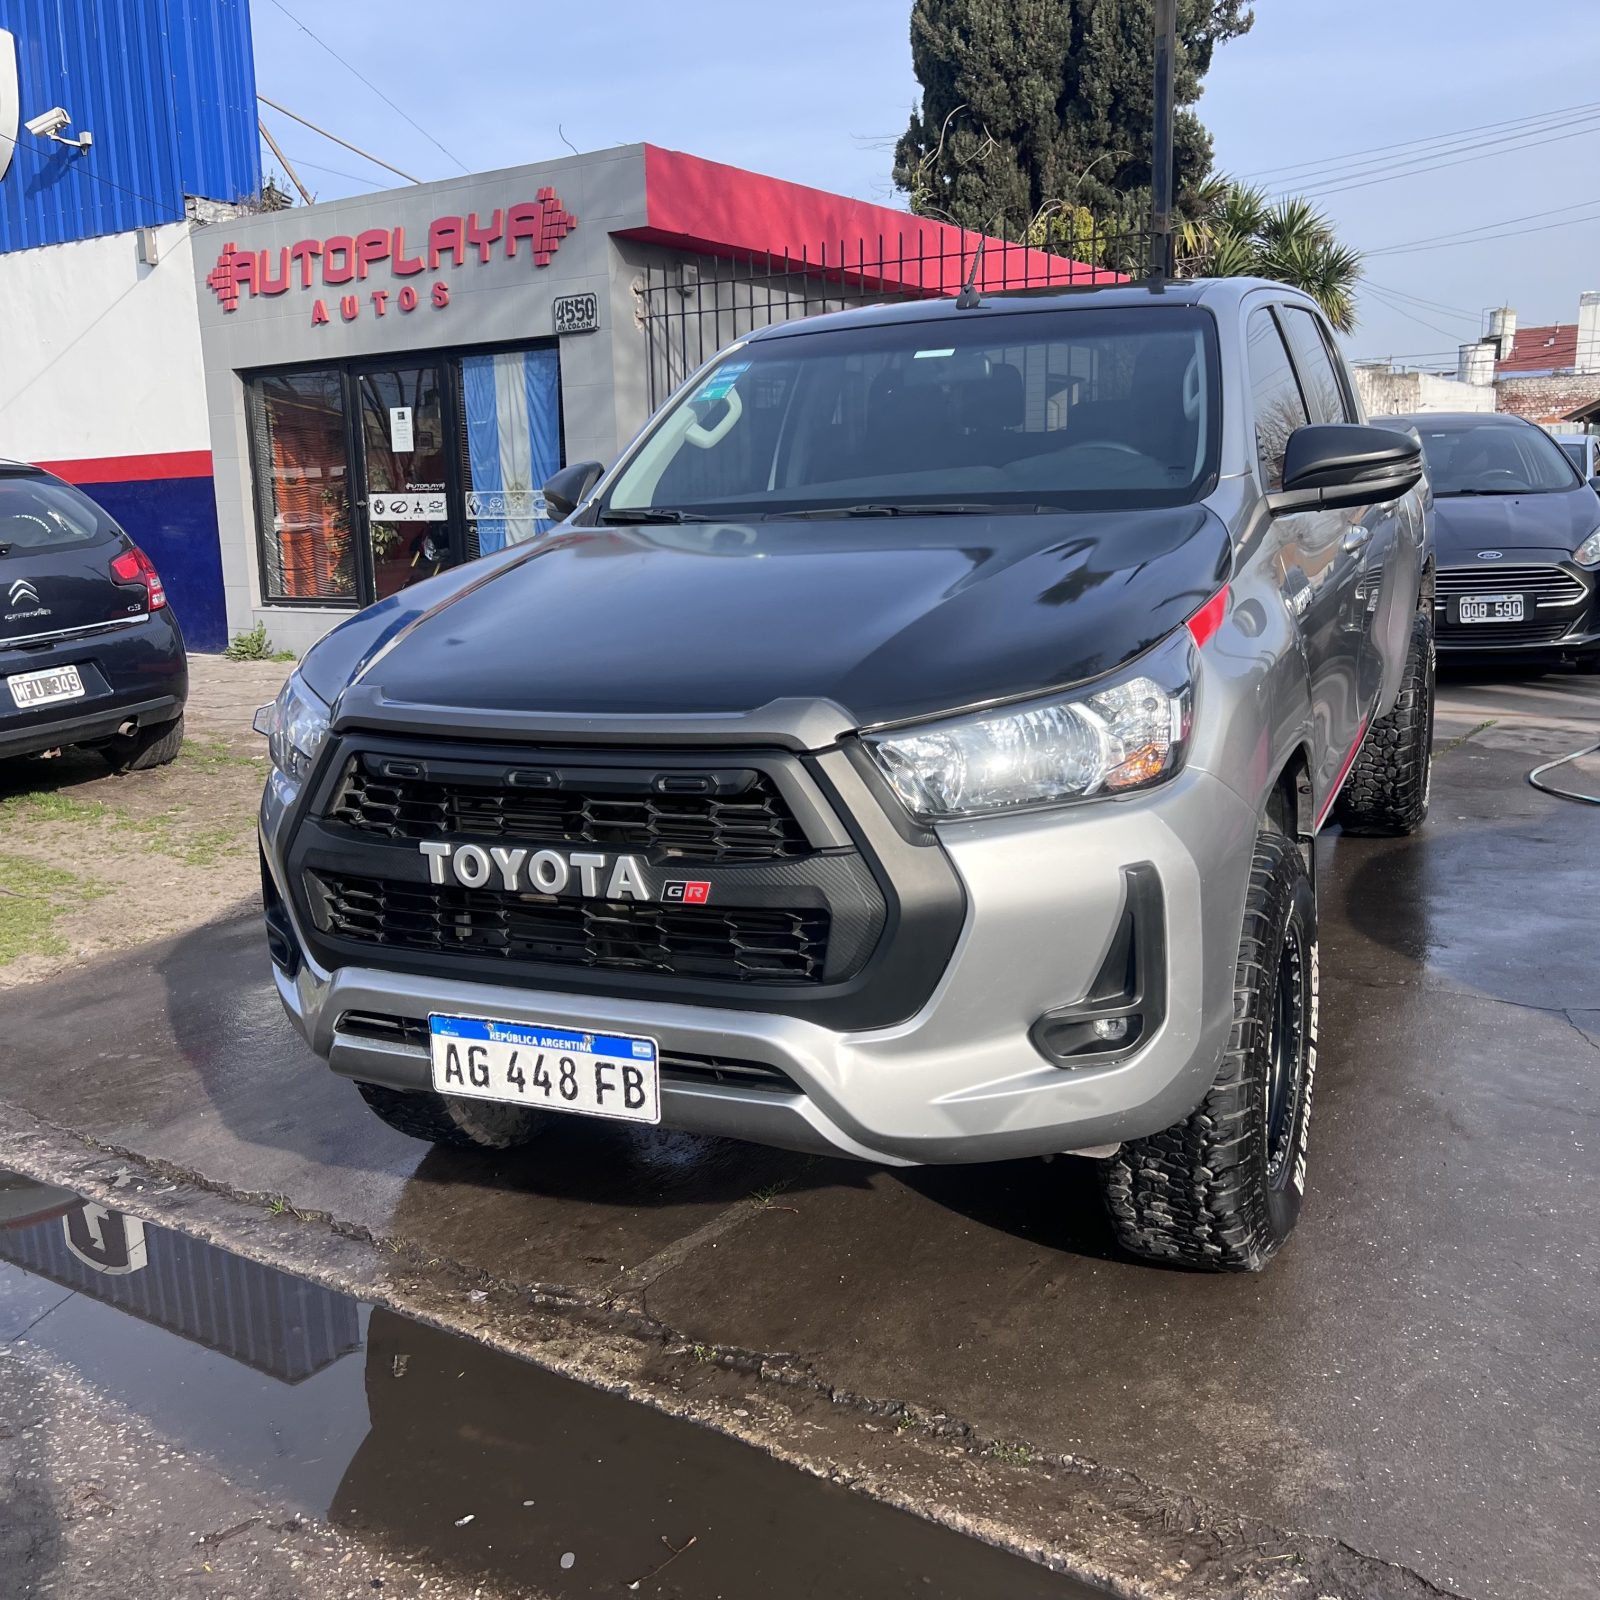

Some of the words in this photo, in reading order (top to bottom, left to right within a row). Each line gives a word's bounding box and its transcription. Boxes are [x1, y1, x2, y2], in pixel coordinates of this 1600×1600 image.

[230, 201, 545, 297] AUTOPLAYA
[311, 280, 451, 325] AUTOS
[556, 297, 595, 323] 4550
[1495, 601, 1521, 616] 590
[13, 680, 45, 702] MFU
[53, 674, 81, 695] 349
[419, 841, 650, 901] TOYOTA
[666, 884, 705, 899] GR
[489, 1030, 538, 1046] REPÚBLICA
[540, 1036, 592, 1053] ARGENTINA
[445, 1042, 491, 1089] AG
[506, 1050, 579, 1101] 448
[594, 1061, 646, 1109] FB
